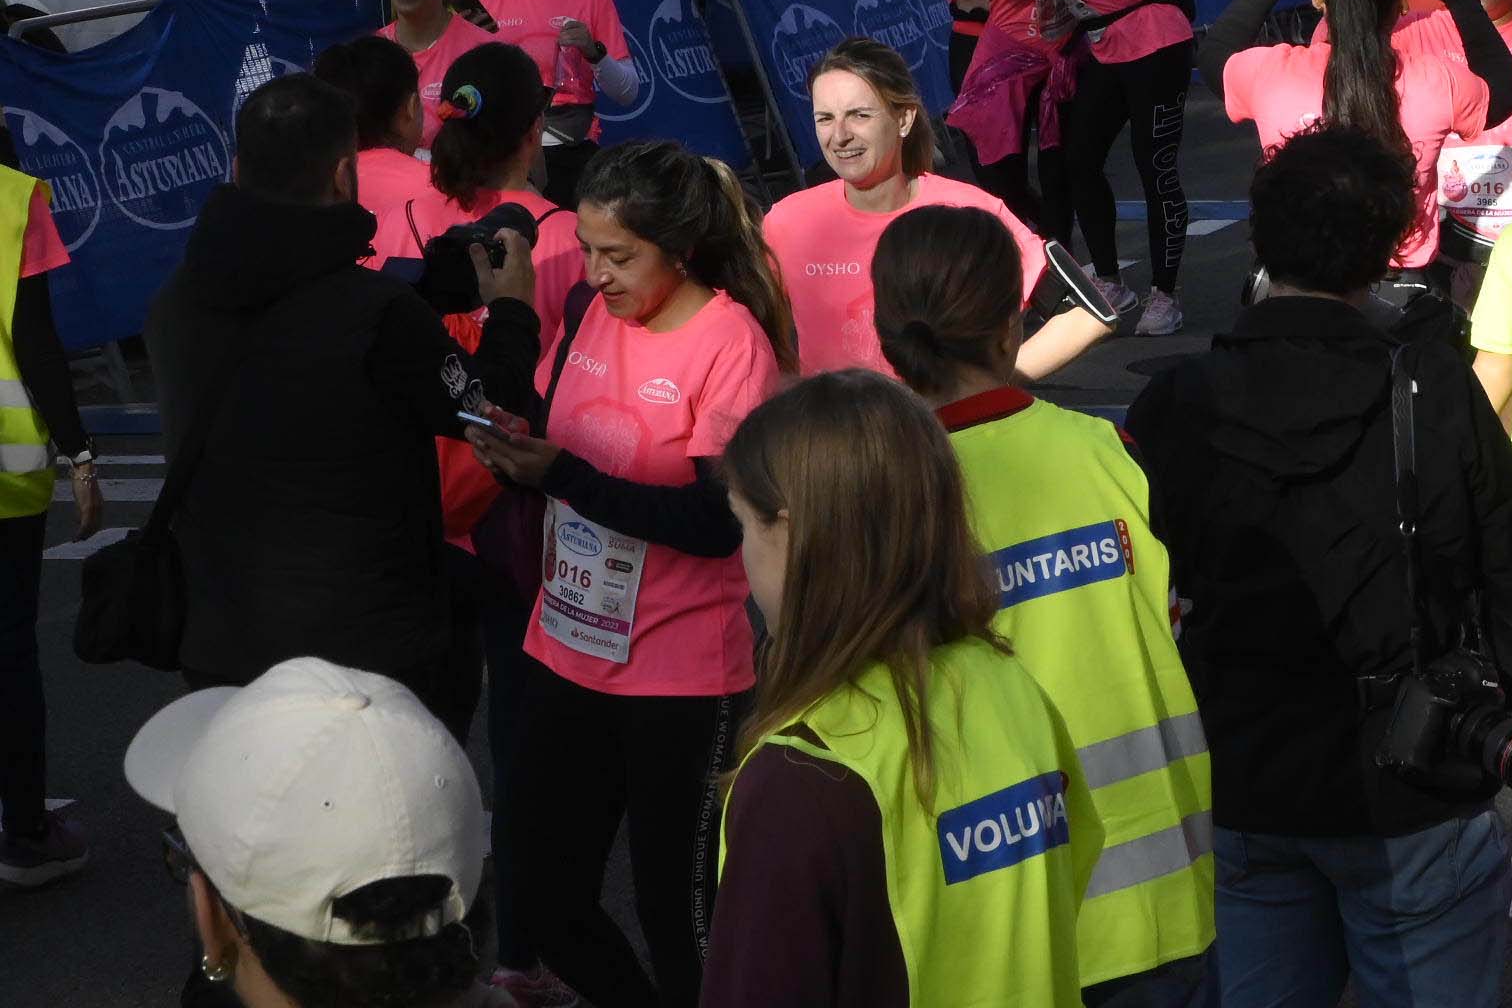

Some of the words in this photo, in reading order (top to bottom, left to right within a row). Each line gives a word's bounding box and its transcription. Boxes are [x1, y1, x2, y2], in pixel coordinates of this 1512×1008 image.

[113, 142, 224, 203] ASTURIANA
[1471, 181, 1504, 195] 016
[804, 261, 861, 276] OYSHO
[561, 529, 598, 554] ASTURIANA
[558, 559, 592, 589] 016
[997, 538, 1119, 594] UNTARIS
[559, 584, 585, 606] 30862
[576, 610, 599, 625] MUJER
[579, 630, 620, 650] Santander
